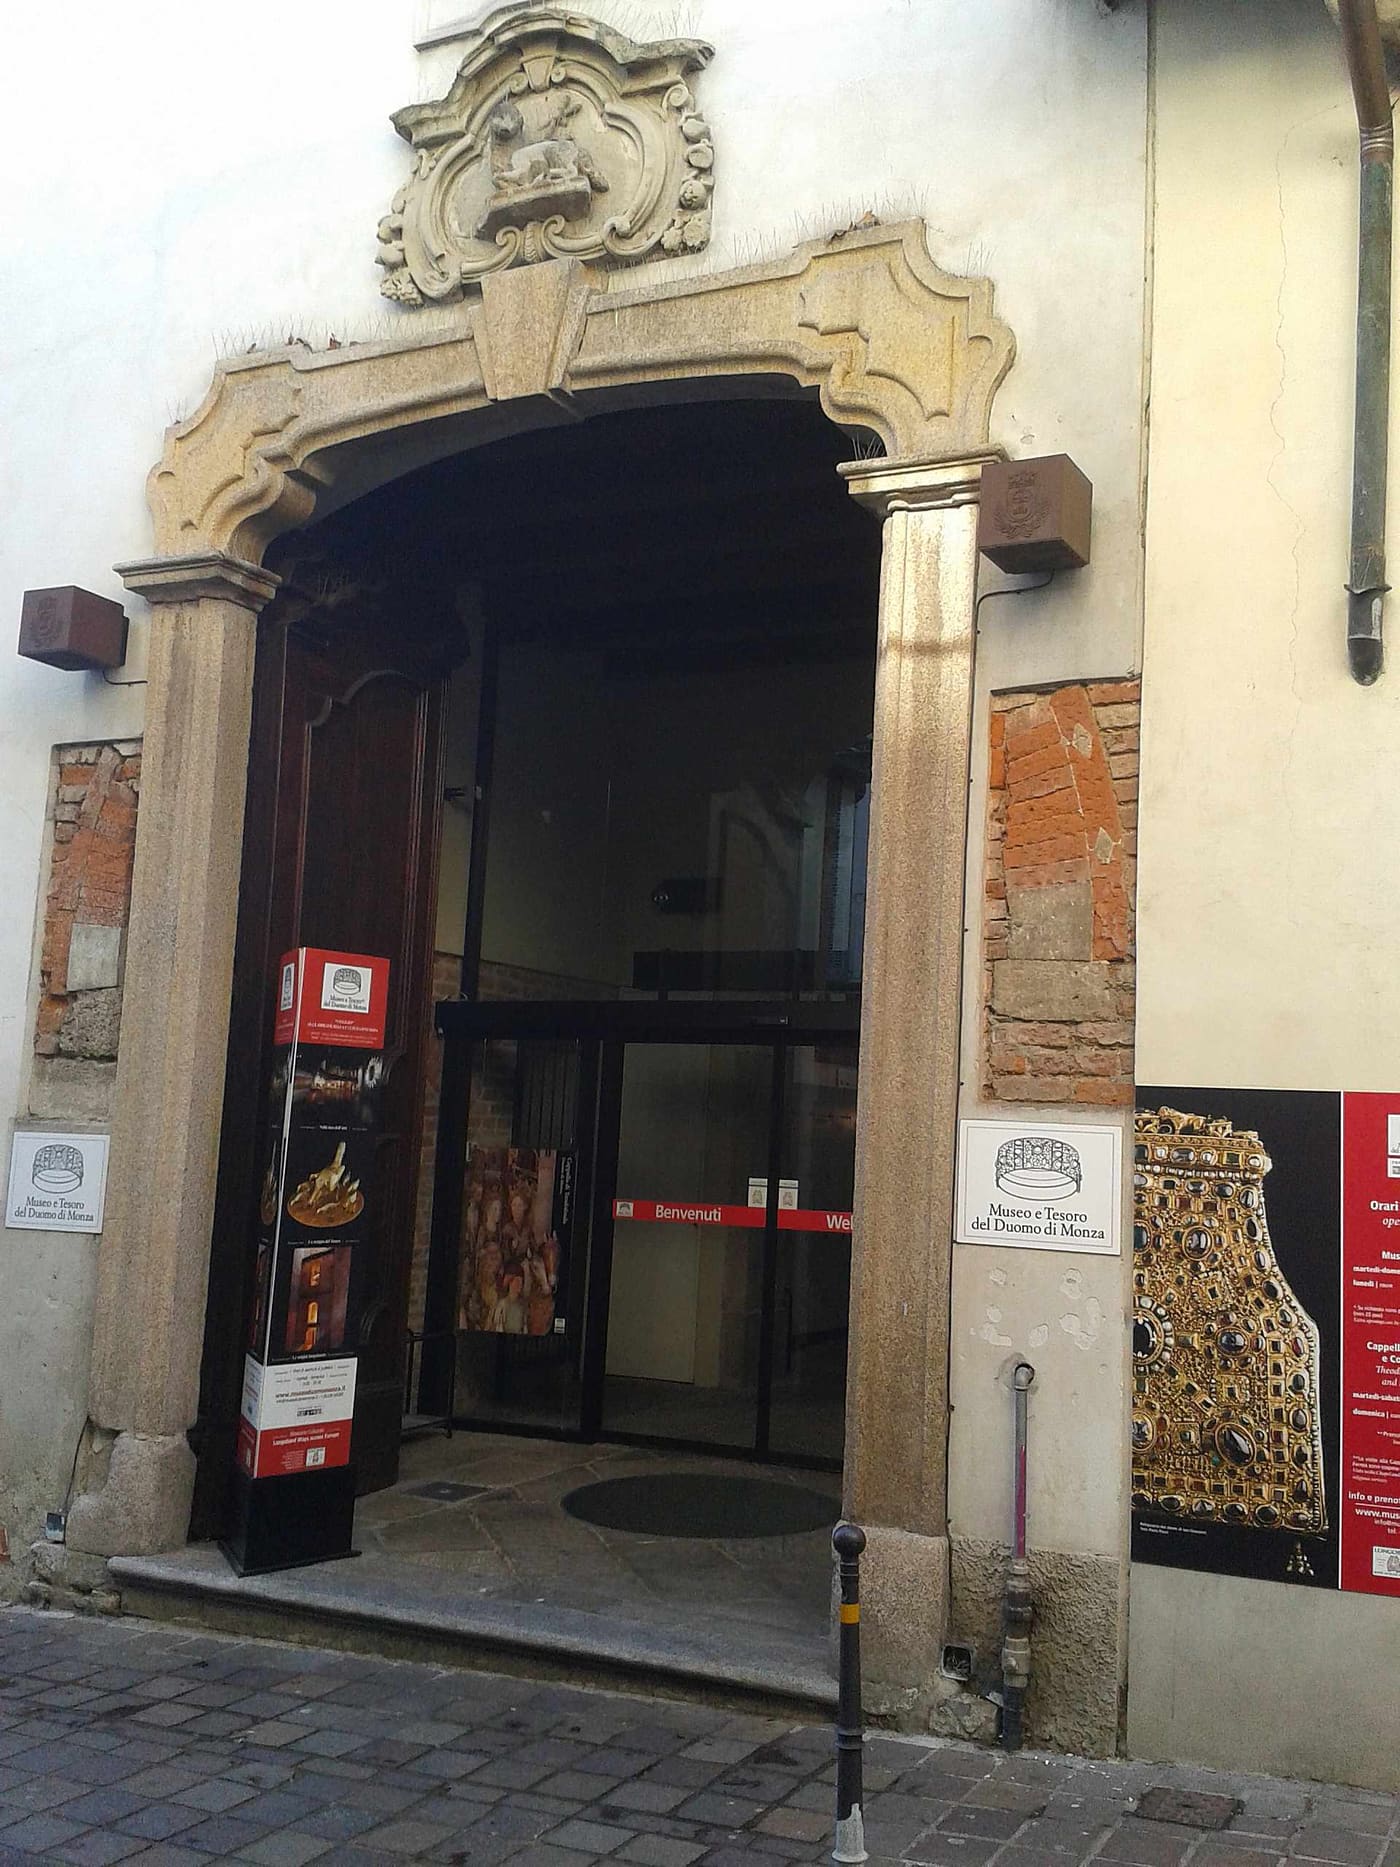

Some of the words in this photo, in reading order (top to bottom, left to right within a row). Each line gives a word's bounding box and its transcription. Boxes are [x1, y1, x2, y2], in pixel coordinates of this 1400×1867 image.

[26, 1196, 52, 1208] Museo
[59, 1198, 84, 1209] Tesoro
[1370, 1200, 1399, 1211] Orari
[14, 1207, 26, 1218] del
[28, 1208, 57, 1220] Duomo
[57, 1209, 65, 1220] di
[67, 1211, 94, 1222] Monza
[655, 1204, 722, 1222] Benvenuti
[989, 1203, 1032, 1219] Museo
[1035, 1210, 1042, 1219] e
[1044, 1207, 1088, 1223] Tesoro
[971, 1216, 990, 1230] del
[994, 1219, 1042, 1235] Duomo
[1044, 1221, 1057, 1236] di
[1060, 1223, 1105, 1240] Monza
[1382, 1378, 1398, 1386] and
[1348, 1491, 1366, 1500] info
